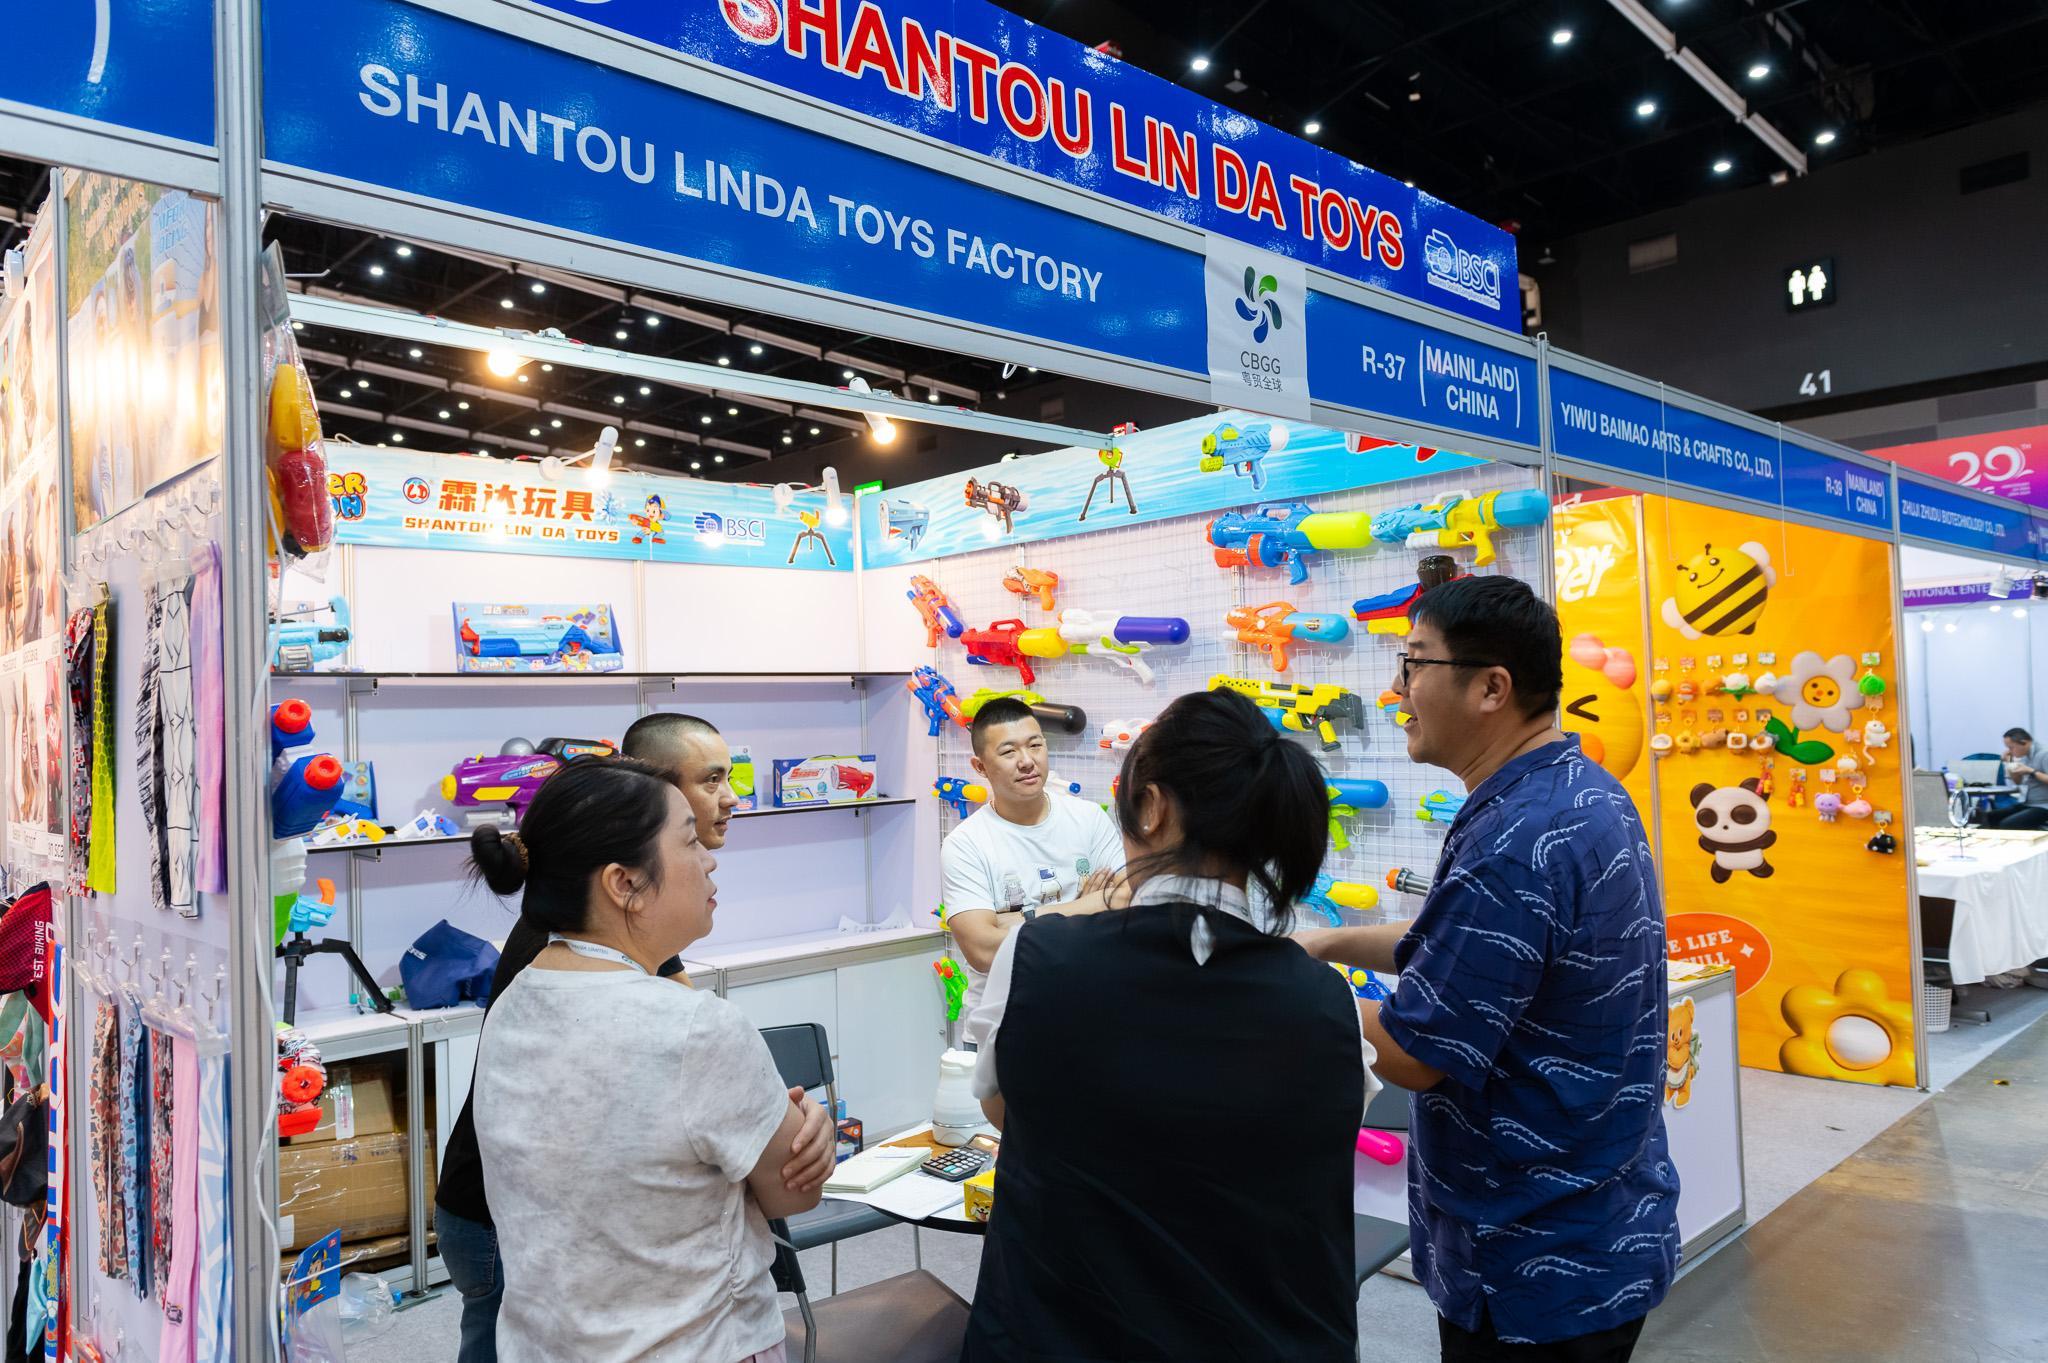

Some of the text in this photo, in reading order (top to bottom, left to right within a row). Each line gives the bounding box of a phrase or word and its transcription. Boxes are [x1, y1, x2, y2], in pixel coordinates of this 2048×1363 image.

[720, 0, 1404, 270] SHANTOU LIN DA TOYS
[359, 63, 1103, 303] SHANTOU LINDA TOYS FACTORY
[1458, 248, 1500, 299] BSCI
[1240, 350, 1281, 375] CBGG
[1362, 345, 1406, 382] R-37
[1799, 369, 1832, 396] 41
[1446, 384, 1500, 421] CHINA
[1561, 402, 1774, 479] YIWU BAIMAO ARTS & CRAFTS CO., LTD.
[1825, 476, 1843, 497] R-39
[1856, 496, 1878, 516] CHINA
[542, 527, 565, 538] DA
[575, 528, 619, 541] TOYS
[726, 518, 765, 538] BSCI
[1960, 580, 2030, 596] ENTESE
[33, 920, 45, 981] EST BIKING
[1685, 929, 1734, 951] LIFE
